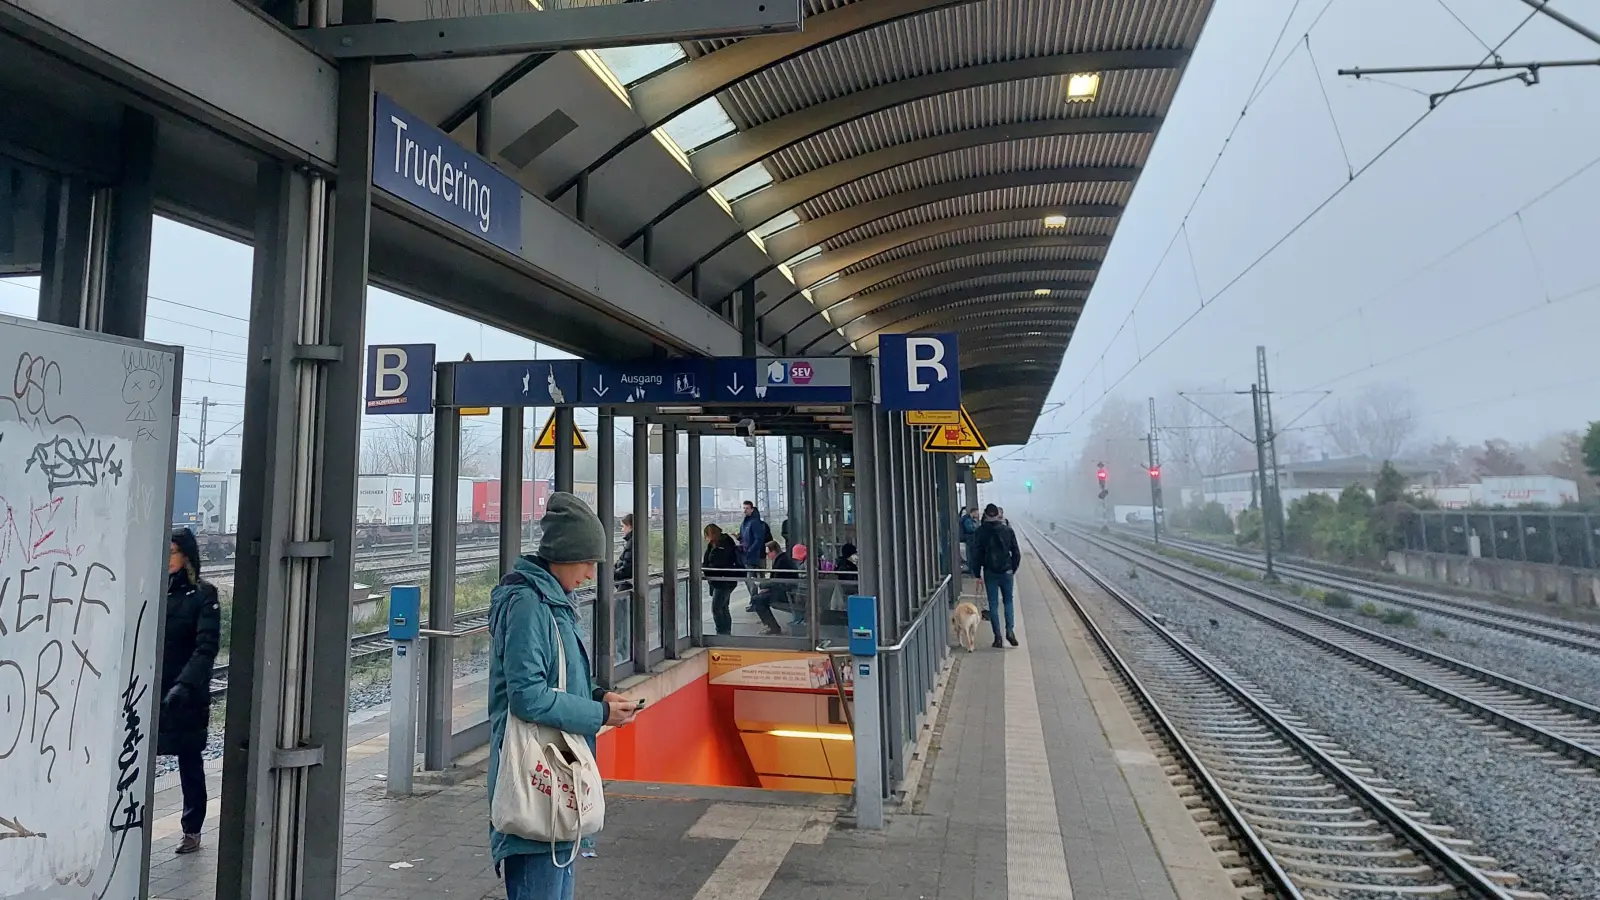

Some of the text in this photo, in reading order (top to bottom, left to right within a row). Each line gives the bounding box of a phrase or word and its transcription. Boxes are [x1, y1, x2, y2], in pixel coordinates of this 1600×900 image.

[390, 114, 492, 234] Trudering
[375, 347, 409, 398] B
[620, 373, 663, 385] Ausgang
[791, 367, 811, 377] SEV
[905, 336, 949, 392] B
[393, 491, 431, 504] DB SCHKER
